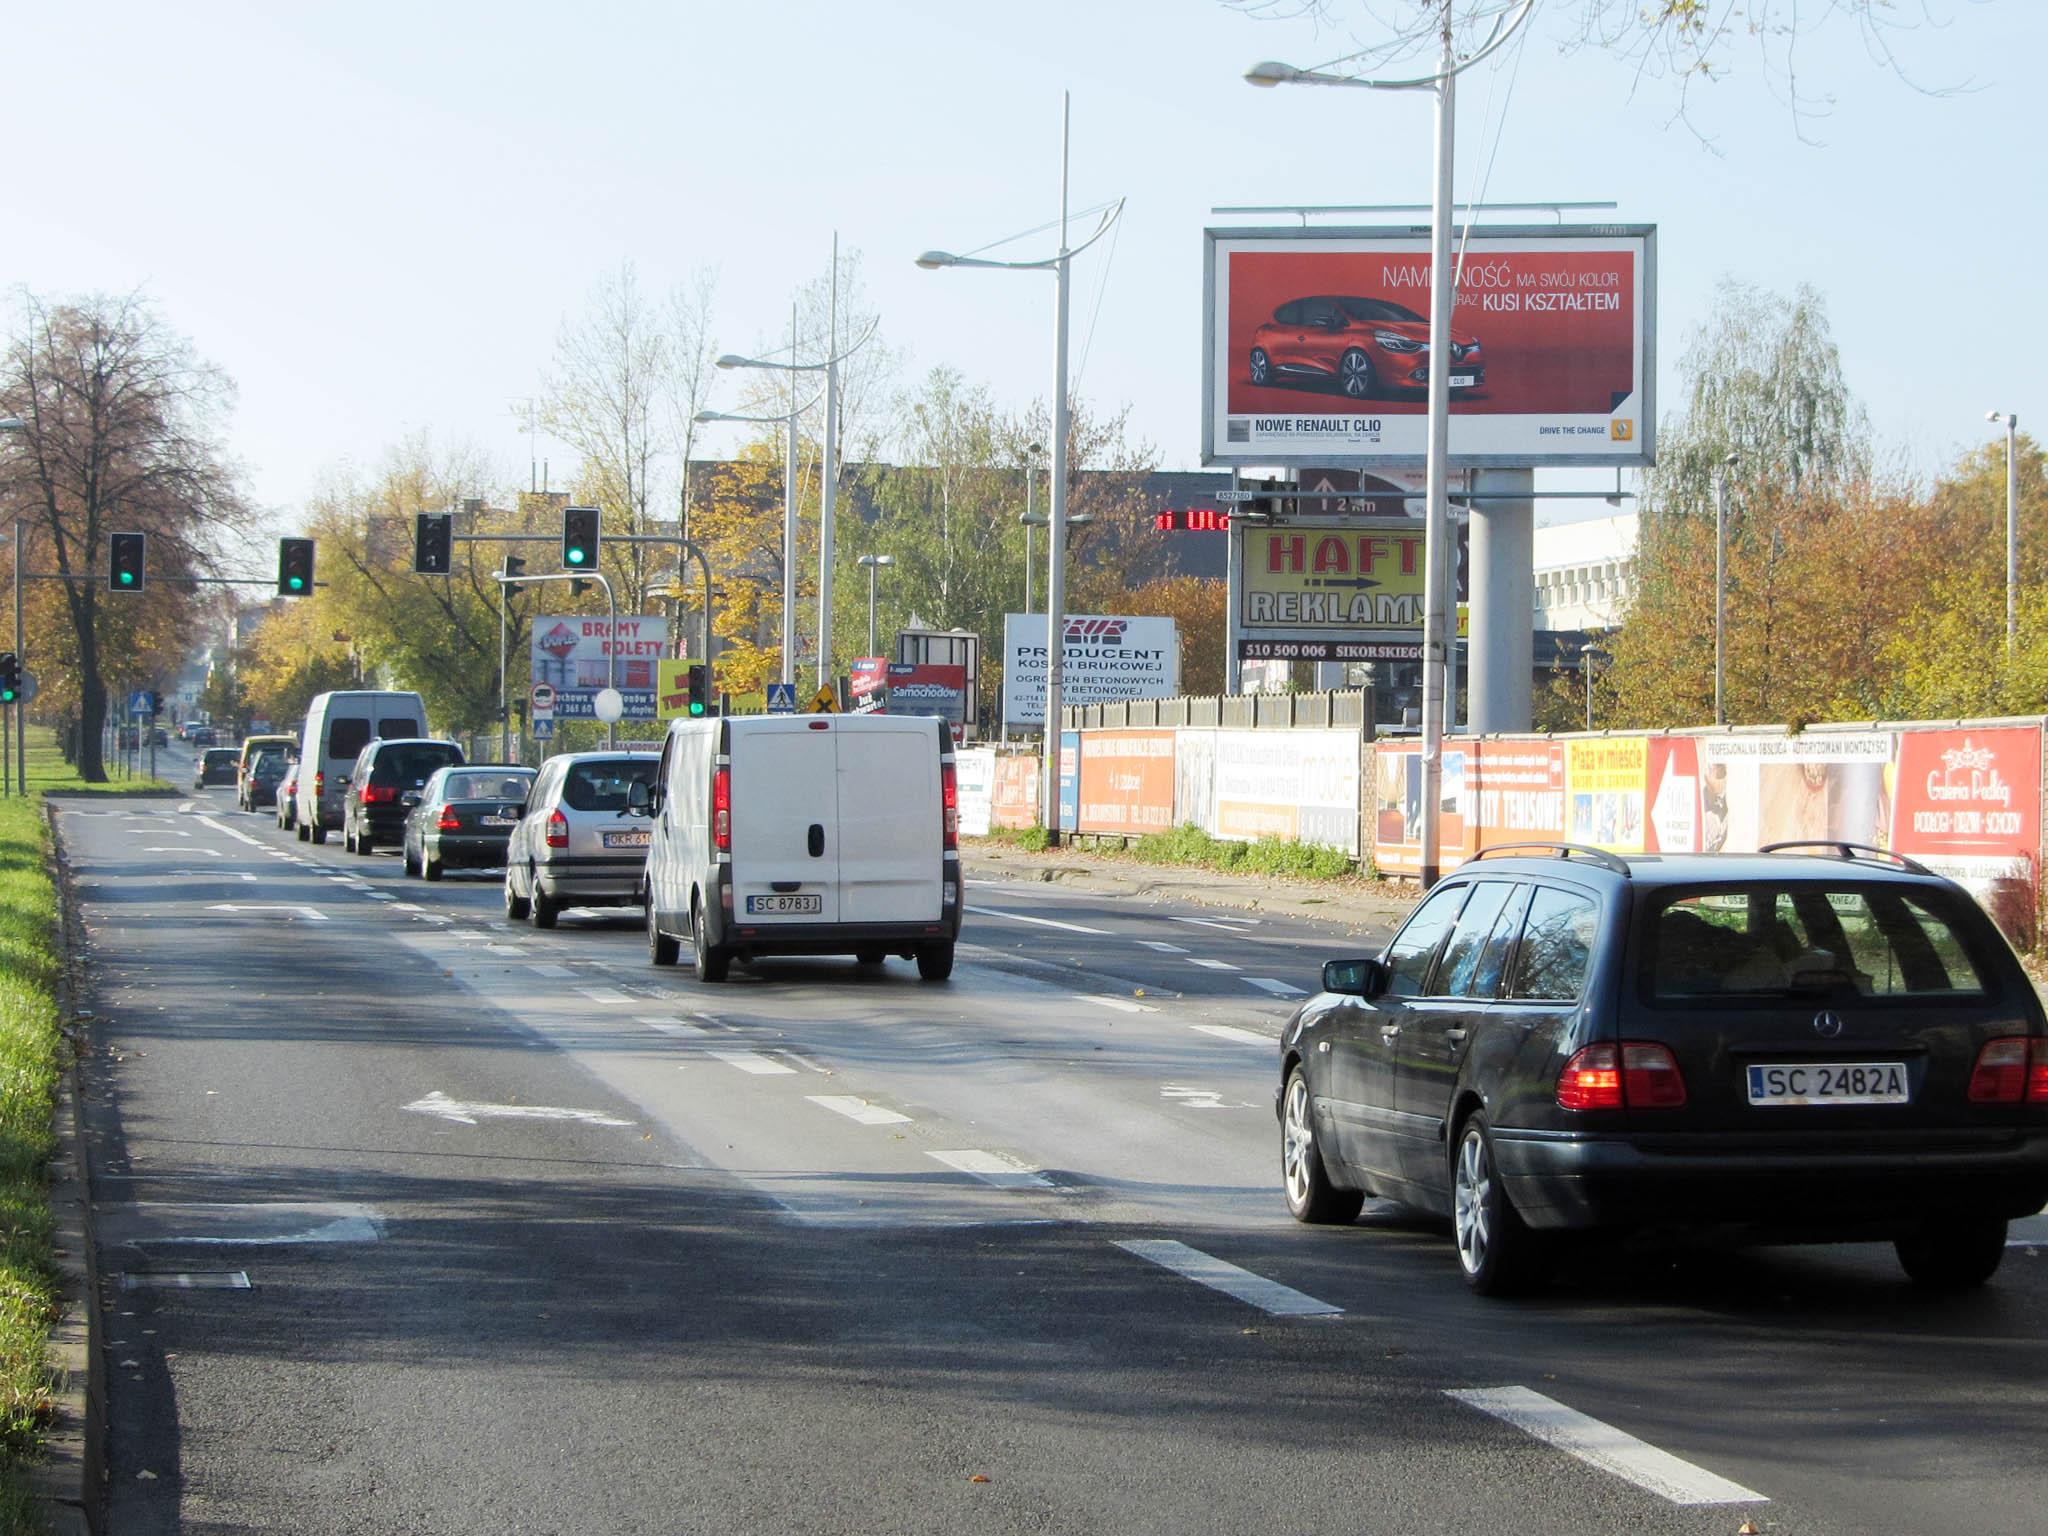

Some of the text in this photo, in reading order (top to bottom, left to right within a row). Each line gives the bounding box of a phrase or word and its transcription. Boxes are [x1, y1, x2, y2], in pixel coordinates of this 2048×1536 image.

[1516, 273, 1536, 287] MA
[1540, 271, 1575, 287] SWÓJ
[1579, 272, 1619, 287] KOLOR
[1483, 294, 1521, 311] KUSI
[1525, 292, 1620, 310] KSZTAŁTEM
[1255, 419, 1381, 432] NOWE RENAULT CLIO
[1577, 426, 1606, 434] CHANGE
[1337, 499, 1346, 512] 2
[1267, 534, 1424, 576] HAFT
[1246, 645, 1270, 656] 510
[1273, 645, 1298, 656] 500
[1301, 646, 1326, 657] 006
[1078, 661, 1162, 671] BRUKOWEJ
[1083, 676, 1164, 684] BETONOWYCH
[1072, 686, 1143, 695] BETONOWEJ
[1927, 770, 1969, 801] Galeria
[1503, 791, 1563, 831] TENISOWE
[757, 898, 817, 910] SC 8783J
[1767, 1067, 1902, 1096] SC 2482A
